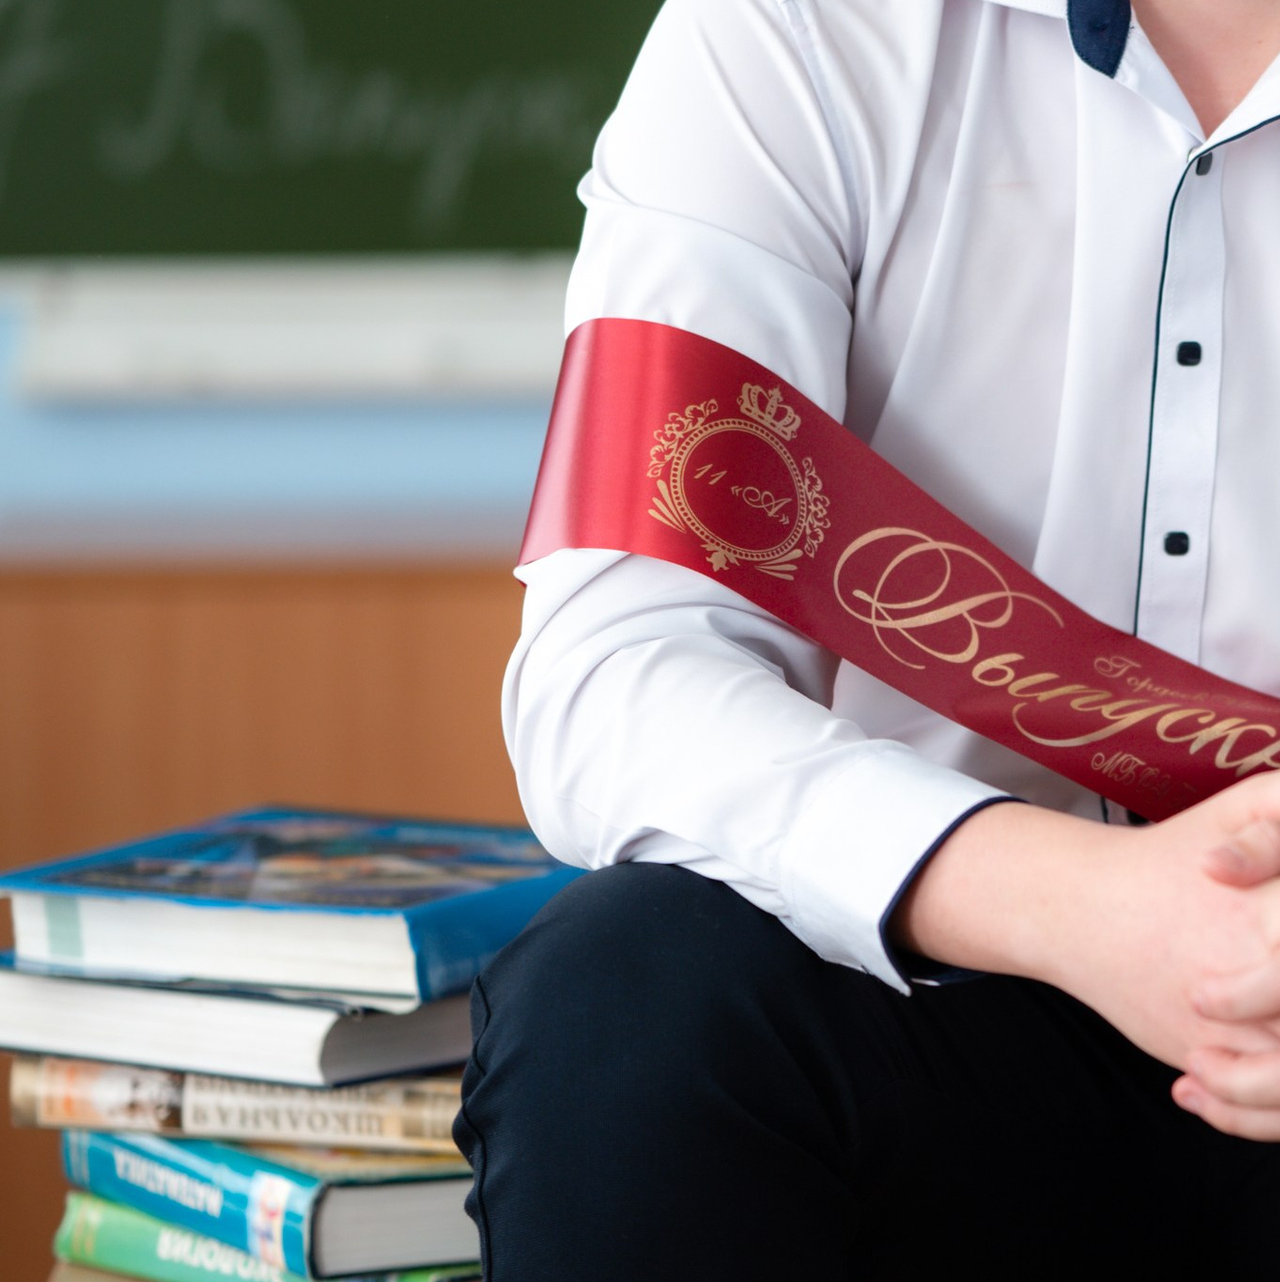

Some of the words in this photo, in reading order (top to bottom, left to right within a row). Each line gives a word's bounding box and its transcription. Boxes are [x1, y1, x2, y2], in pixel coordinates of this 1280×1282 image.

[693, 463, 727, 485] 11
[191, 1106, 386, 1137] ШКОЛЬНАЯ
[113, 1146, 223, 1219] МАТЕМАТИКА
